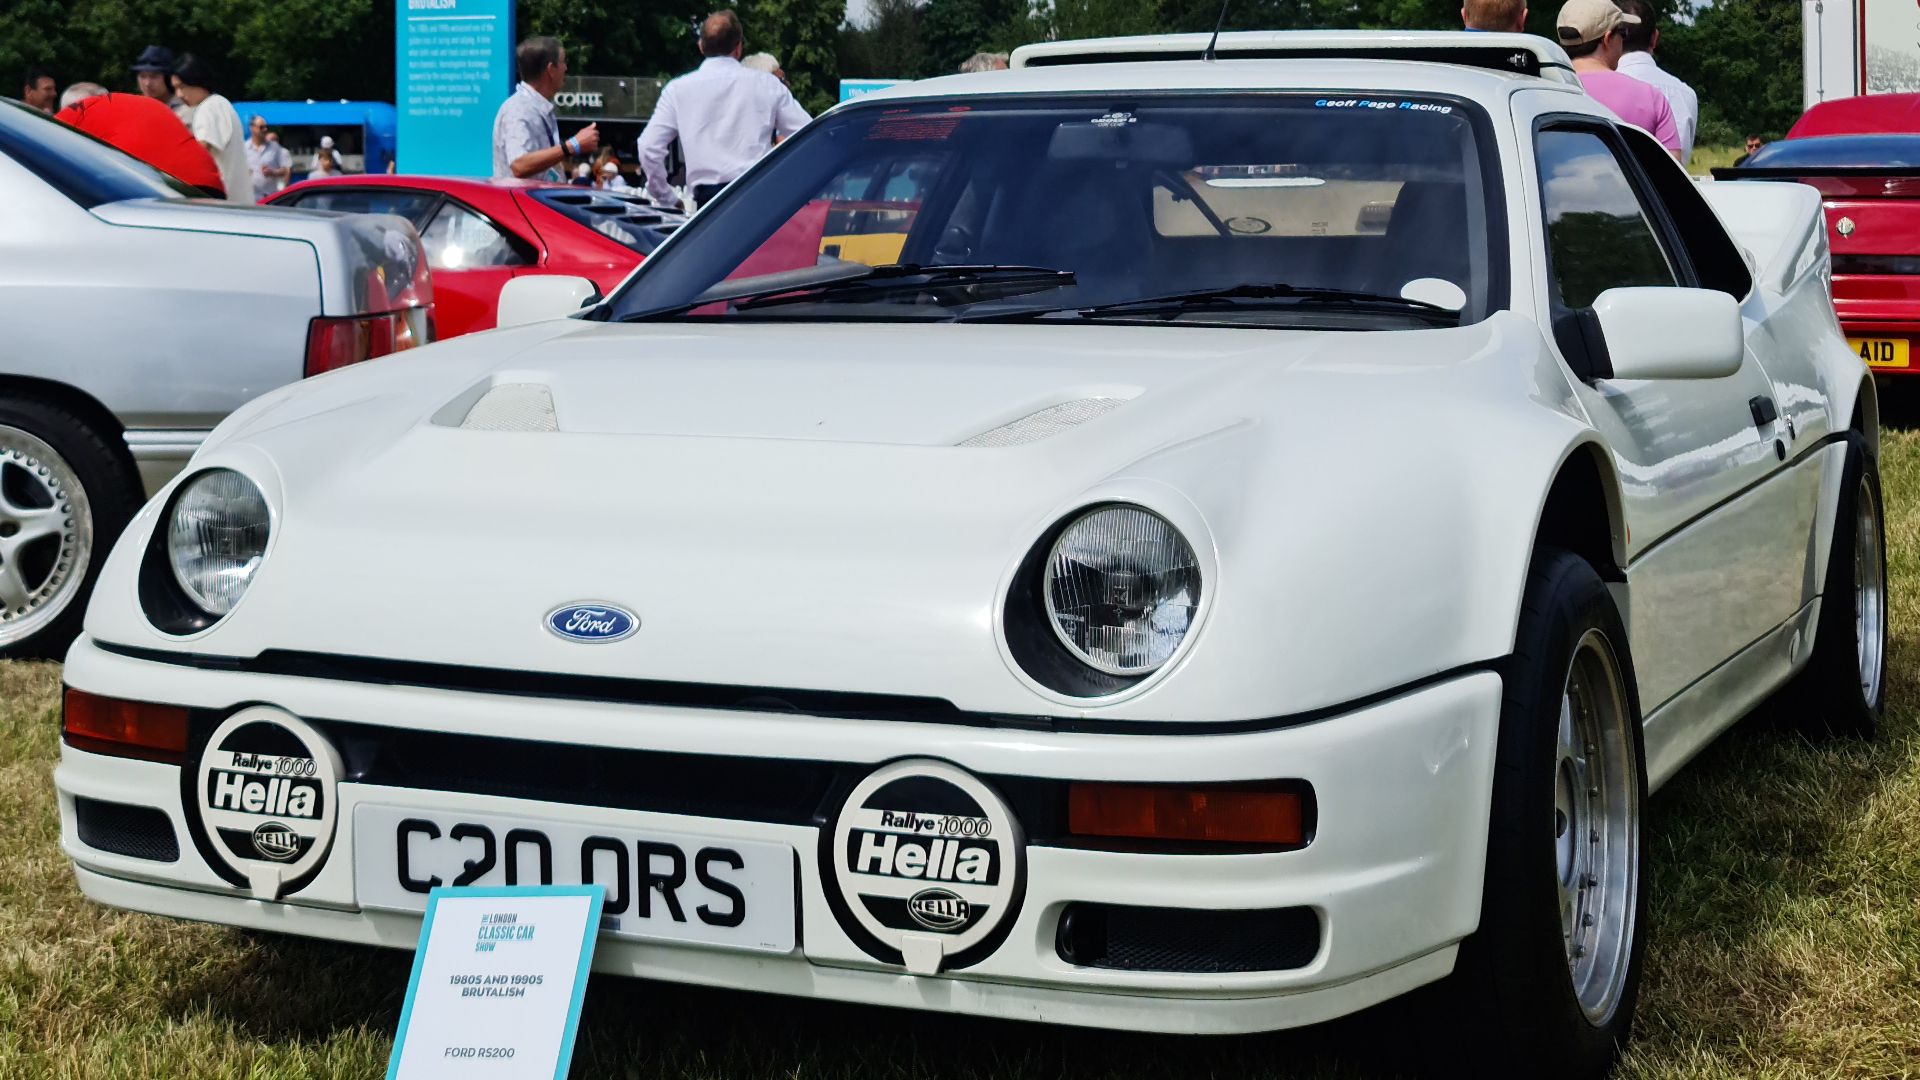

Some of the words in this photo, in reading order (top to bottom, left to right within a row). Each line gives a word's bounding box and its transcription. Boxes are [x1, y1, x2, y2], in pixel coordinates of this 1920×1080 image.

[554, 92, 603, 107] COFFEE
[1315, 99, 1357, 108] Geoff
[1358, 100, 1396, 109] Page
[1399, 102, 1452, 114] Racing
[565, 608, 617, 634] Ford
[232, 751, 273, 772] Rallye
[274, 757, 317, 777] 1000
[213, 772, 316, 817] Hella
[880, 810, 936, 833] Rallye
[937, 815, 992, 838] 1000
[256, 833, 300, 849] HELLA
[396, 818, 553, 894] C20
[857, 832, 991, 884] Hella
[912, 900, 970, 919] HELLA
[489, 913, 517, 923] LONDON
[478, 925, 515, 940] CLASSIC
[516, 925, 535, 940] CAR
[475, 942, 496, 952] SHOW
[450, 975, 482, 985] 1980S
[483, 975, 508, 985] AND
[510, 975, 543, 985] 1990S
[461, 987, 525, 998] BRUTALISM
[444, 1048, 475, 1058] FORD
[477, 1048, 515, 1058] RS200
